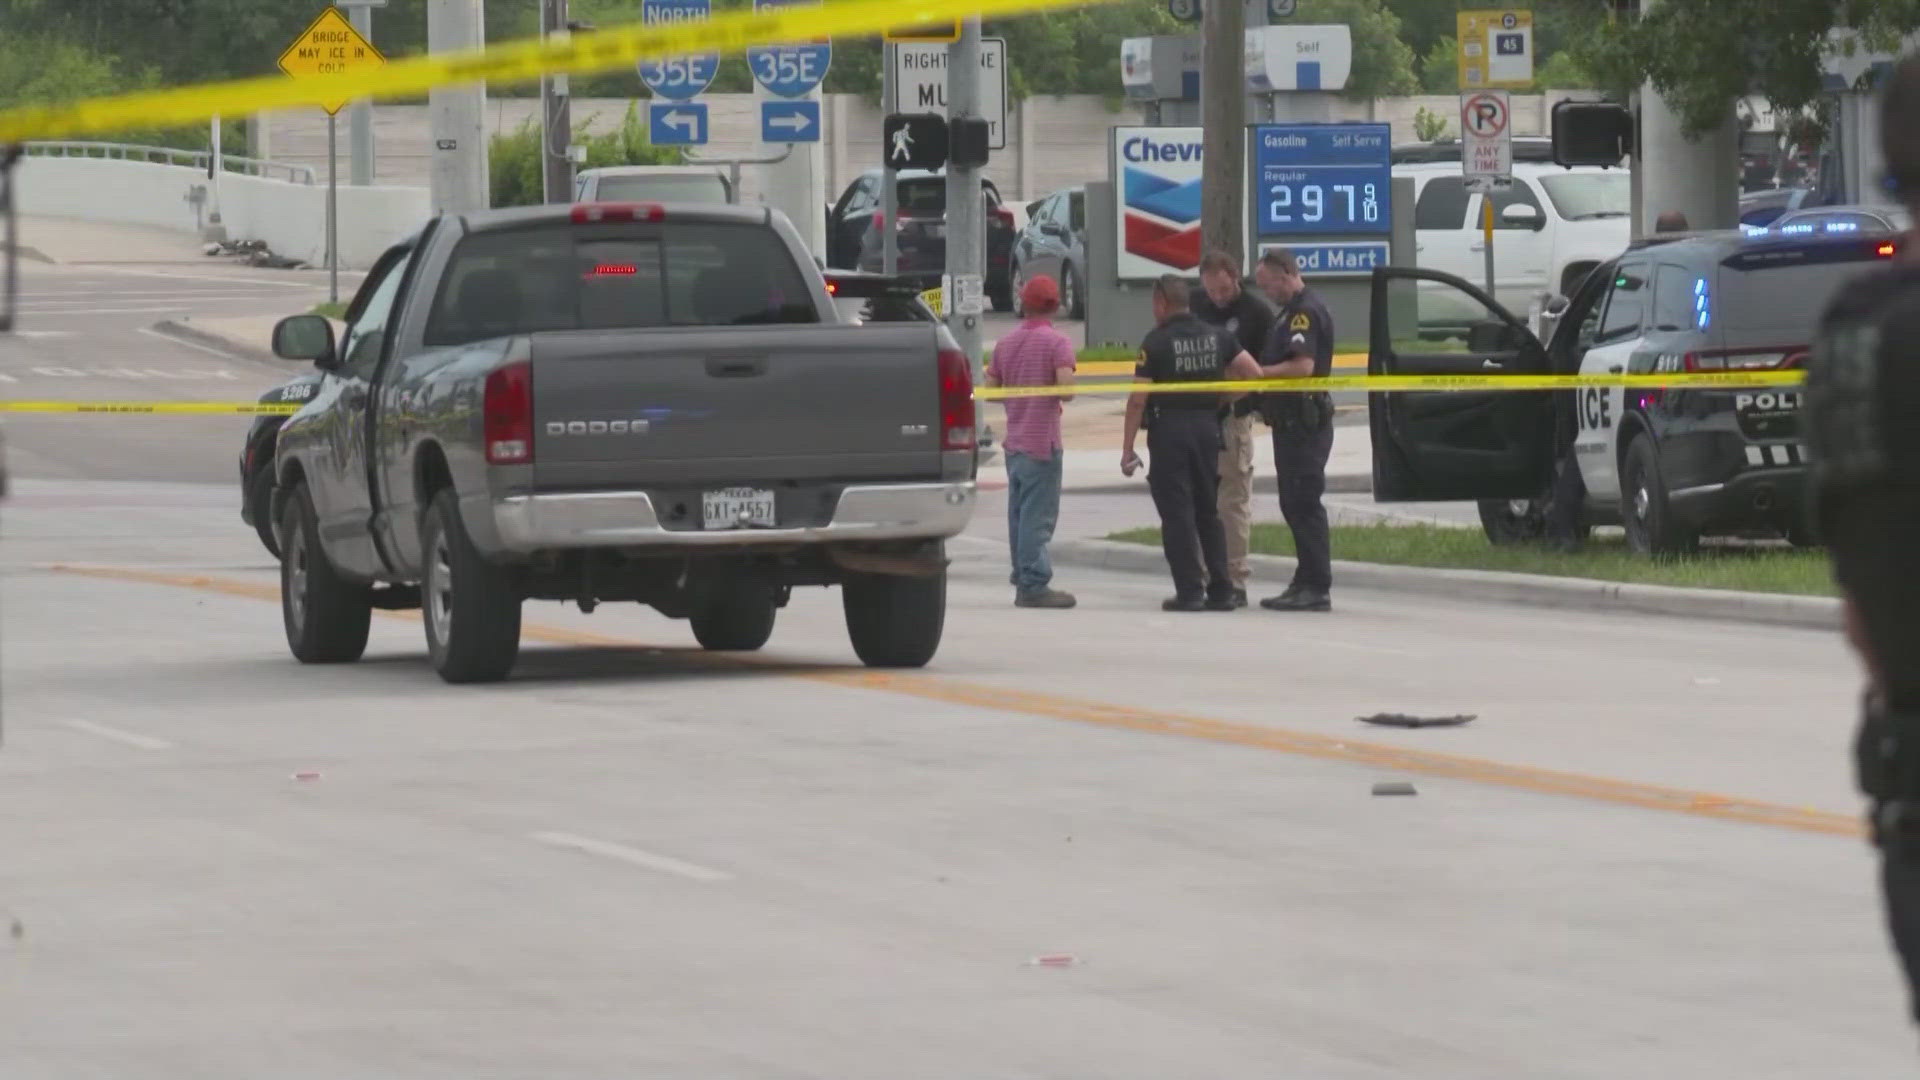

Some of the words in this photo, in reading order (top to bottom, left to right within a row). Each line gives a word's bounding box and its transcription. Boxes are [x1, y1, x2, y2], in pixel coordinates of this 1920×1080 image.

[648, 5, 706, 25] NORTH
[313, 32, 350, 43] BRIDGE
[1503, 38, 1517, 51] 45
[298, 48, 320, 59] MAY
[329, 48, 346, 58] ICE
[354, 48, 365, 58] IN
[1296, 41, 1320, 53] Self
[904, 53, 948, 69] RIGHT
[1182, 52, 1200, 63] Sel
[646, 55, 707, 87] 35E
[758, 53, 819, 84] 35E
[1264, 134, 1308, 148] Gasoline
[1332, 135, 1351, 147] Self
[1354, 135, 1382, 147] Serve
[1123, 137, 1203, 162] Chevr
[1475, 146, 1500, 157] ANY
[1474, 160, 1500, 171] TIME
[1264, 171, 1306, 182] Regular
[1296, 250, 1319, 268] od
[1327, 250, 1377, 268] Mart
[1174, 336, 1217, 354] DALLAS
[1175, 353, 1217, 371] POLICE
[1657, 354, 1679, 372] 911
[1735, 393, 1803, 411] POLI
[546, 420, 649, 436] DODGE
